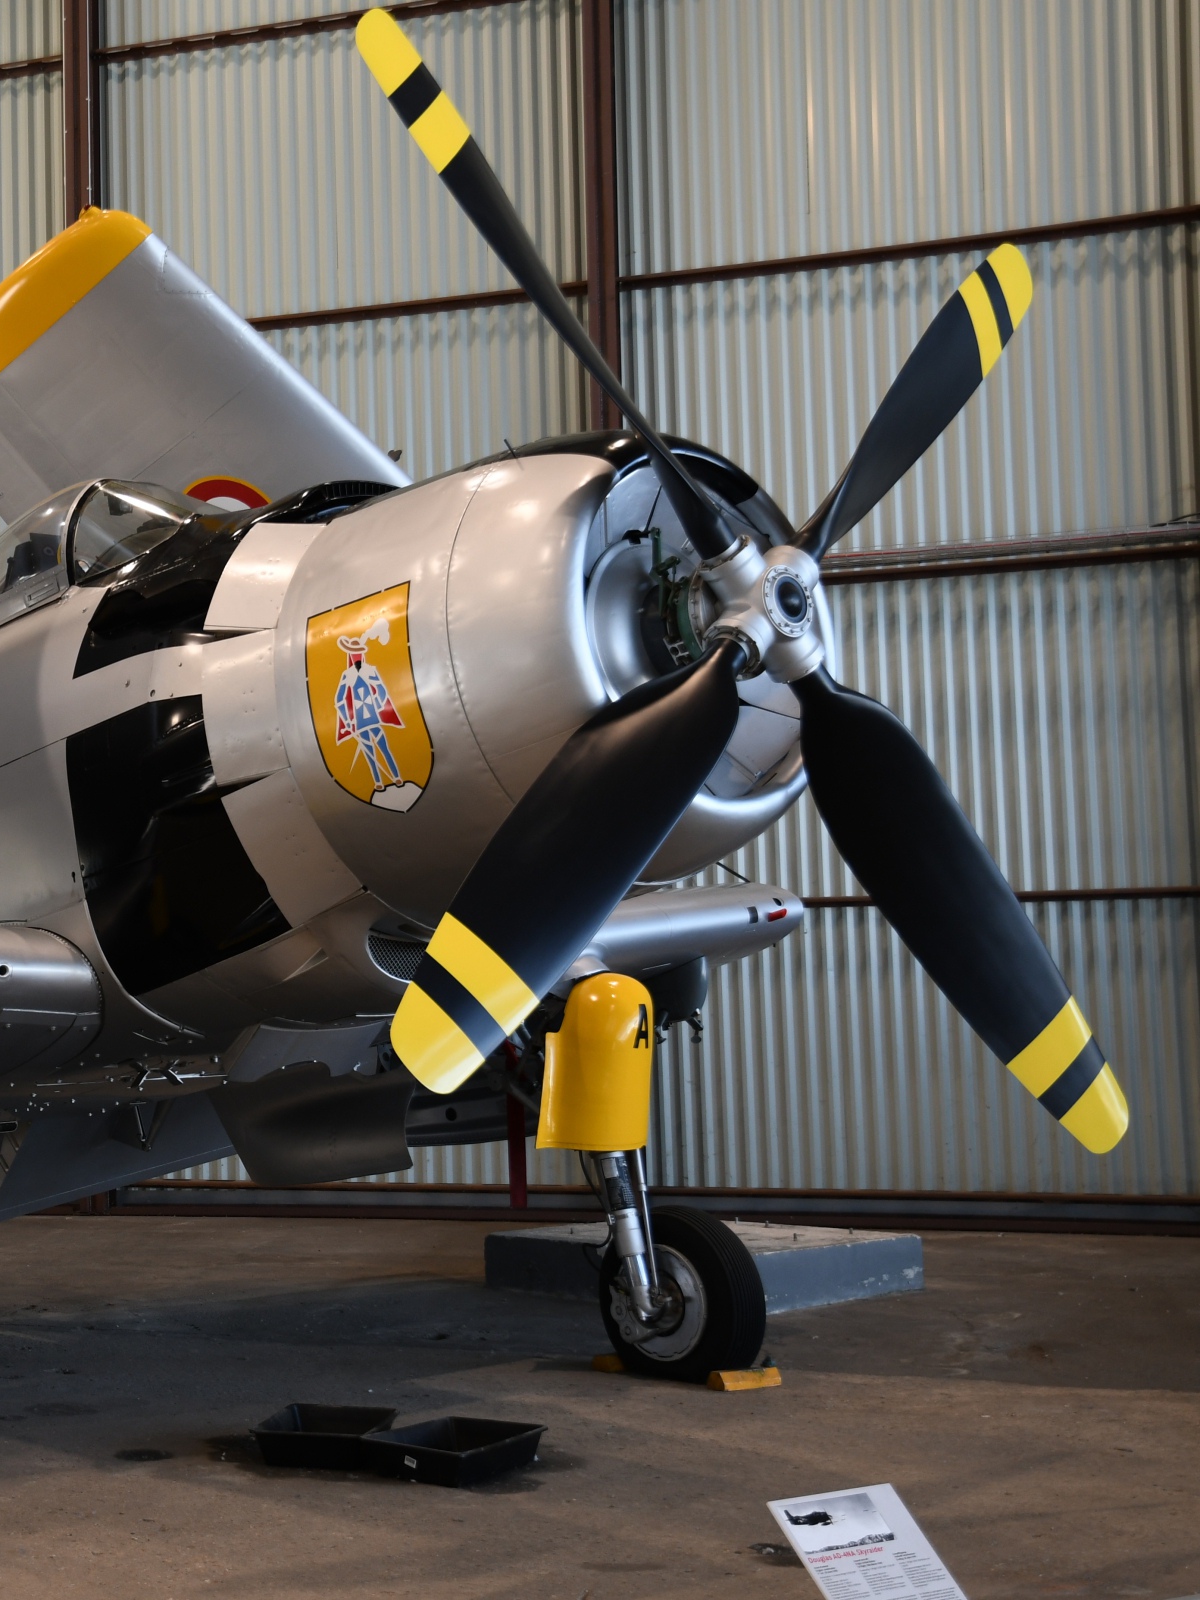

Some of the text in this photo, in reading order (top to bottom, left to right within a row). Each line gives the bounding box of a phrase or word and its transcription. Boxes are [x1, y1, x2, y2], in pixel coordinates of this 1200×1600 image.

[633, 1004, 648, 1049] A
[808, 1554, 833, 1564] Douglas
[856, 1546, 883, 1556] Skyraider
